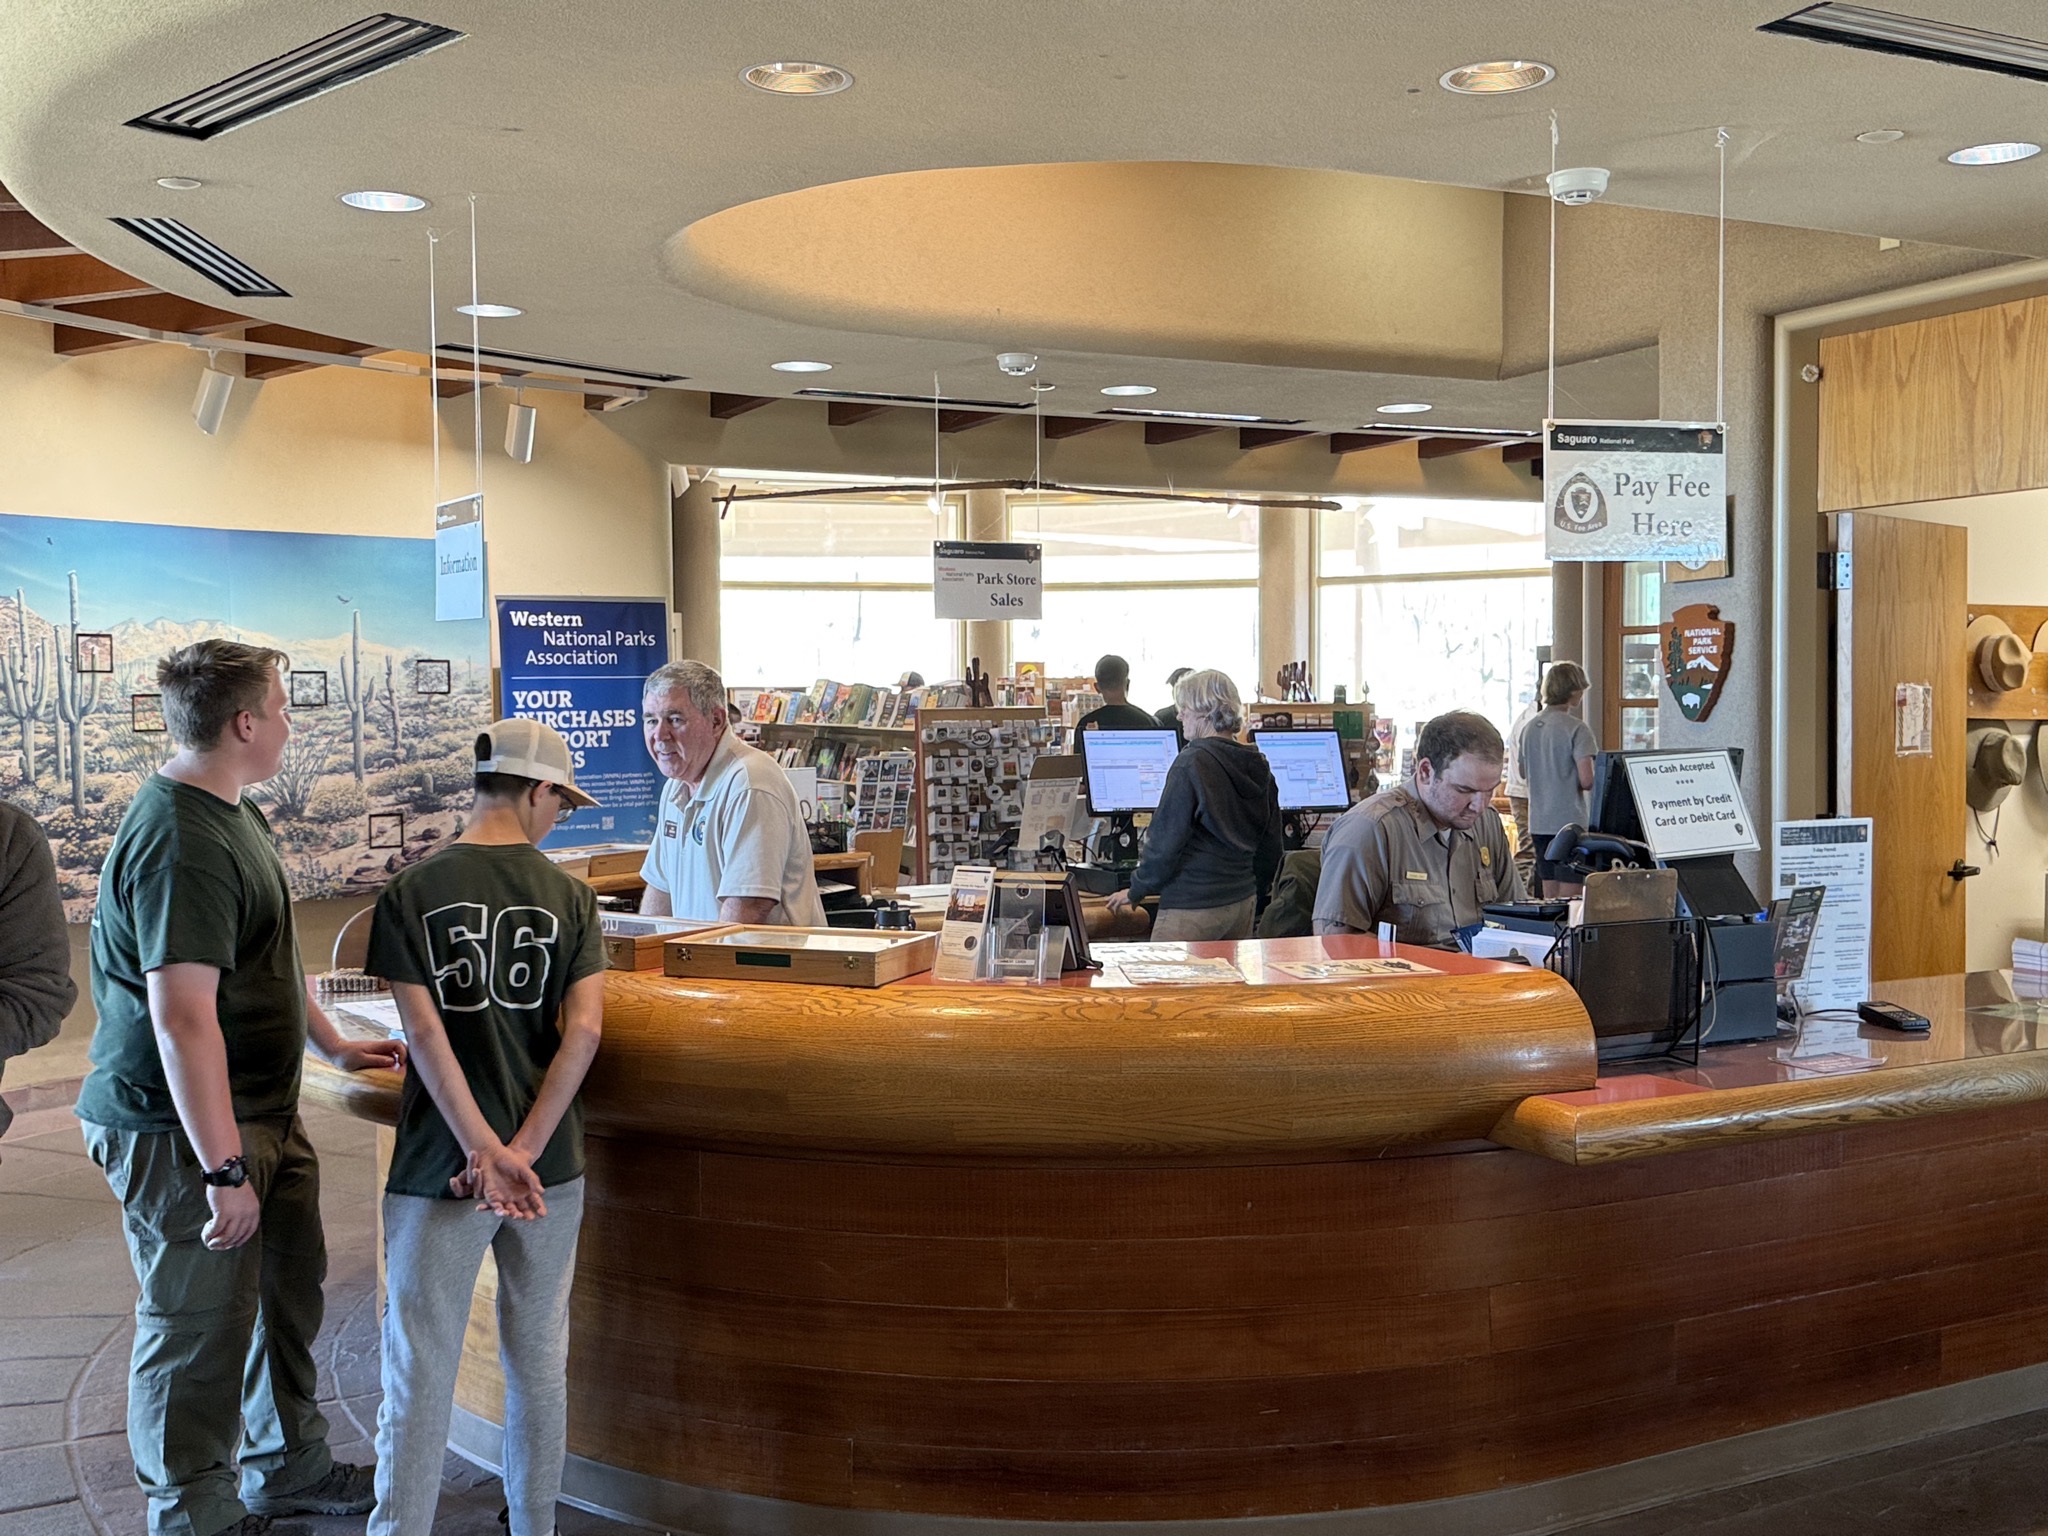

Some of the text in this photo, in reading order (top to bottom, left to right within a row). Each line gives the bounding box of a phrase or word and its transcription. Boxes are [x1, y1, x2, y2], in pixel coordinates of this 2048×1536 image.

[1557, 433, 1598, 446] Saguaro
[1613, 472, 1710, 504] Pay Fee
[1587, 522, 1603, 531] Area
[1631, 512, 1692, 537] Here
[939, 547, 965, 556] Saguaro
[440, 552, 478, 576] Information
[976, 572, 1037, 586] Park Store
[990, 592, 1024, 607] Sales
[509, 610, 583, 628] Western
[543, 630, 656, 647] National Parks
[1684, 627, 1722, 638] NATIONAL
[1687, 645, 1718, 655] SERVICE
[1692, 637, 1713, 646] PARK
[525, 649, 618, 666] Association
[512, 690, 573, 709] YOUR
[559, 730, 611, 748] PORT
[1645, 761, 1715, 775] No Cash Accepted
[1651, 793, 1733, 811] Payment by Credit
[1655, 809, 1736, 827] Card or Debit Card
[421, 901, 559, 1013] 56
